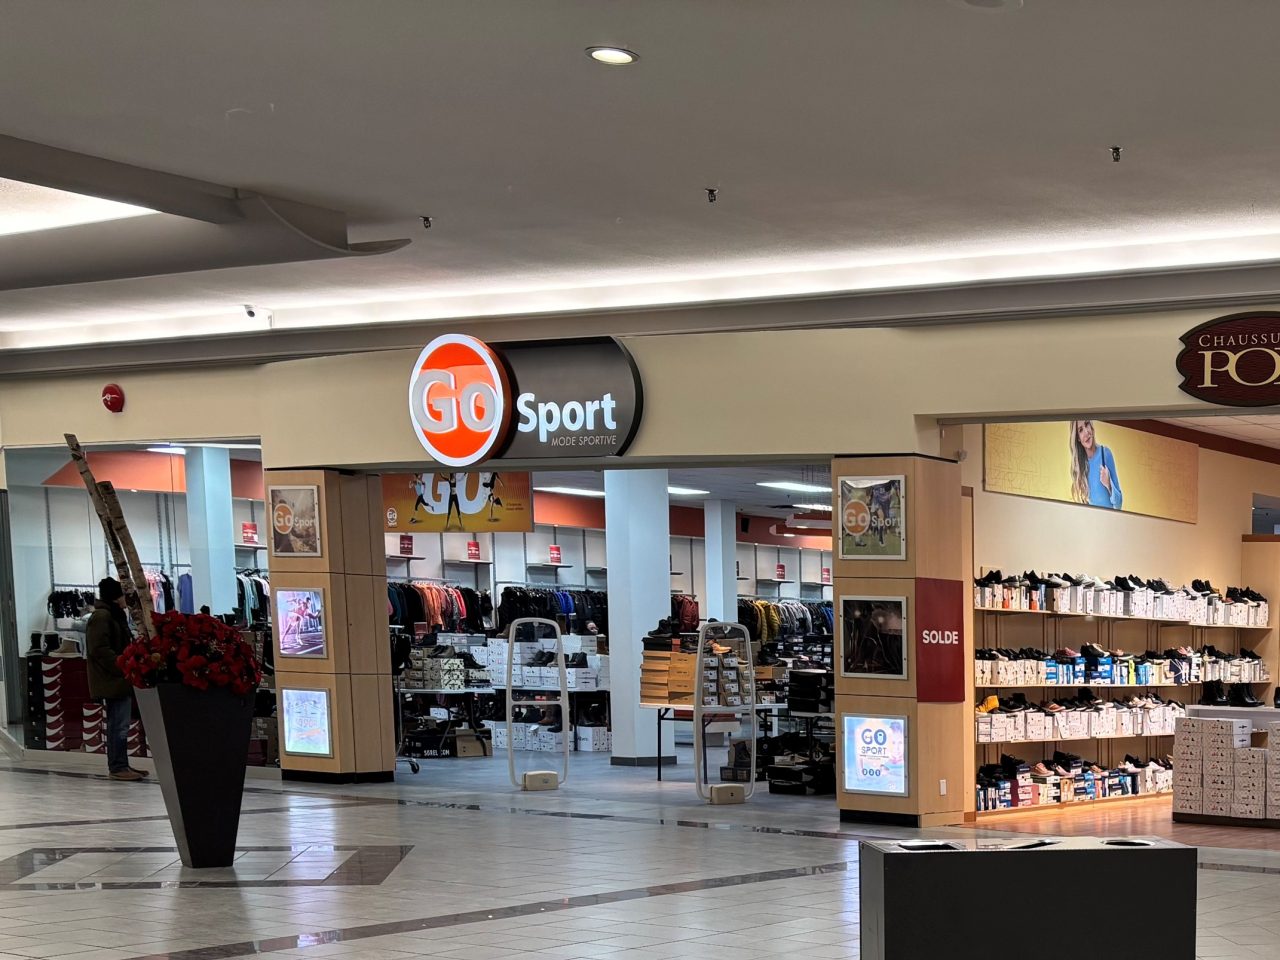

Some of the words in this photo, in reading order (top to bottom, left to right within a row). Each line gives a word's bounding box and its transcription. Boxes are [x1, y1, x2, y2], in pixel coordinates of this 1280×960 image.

[412, 369, 497, 434] Go
[517, 392, 616, 443] Sport
[551, 436, 576, 447] MODE
[579, 434, 617, 446] SPORTIVE
[922, 629, 959, 645] SOLDE
[861, 746, 887, 755] SPORT
